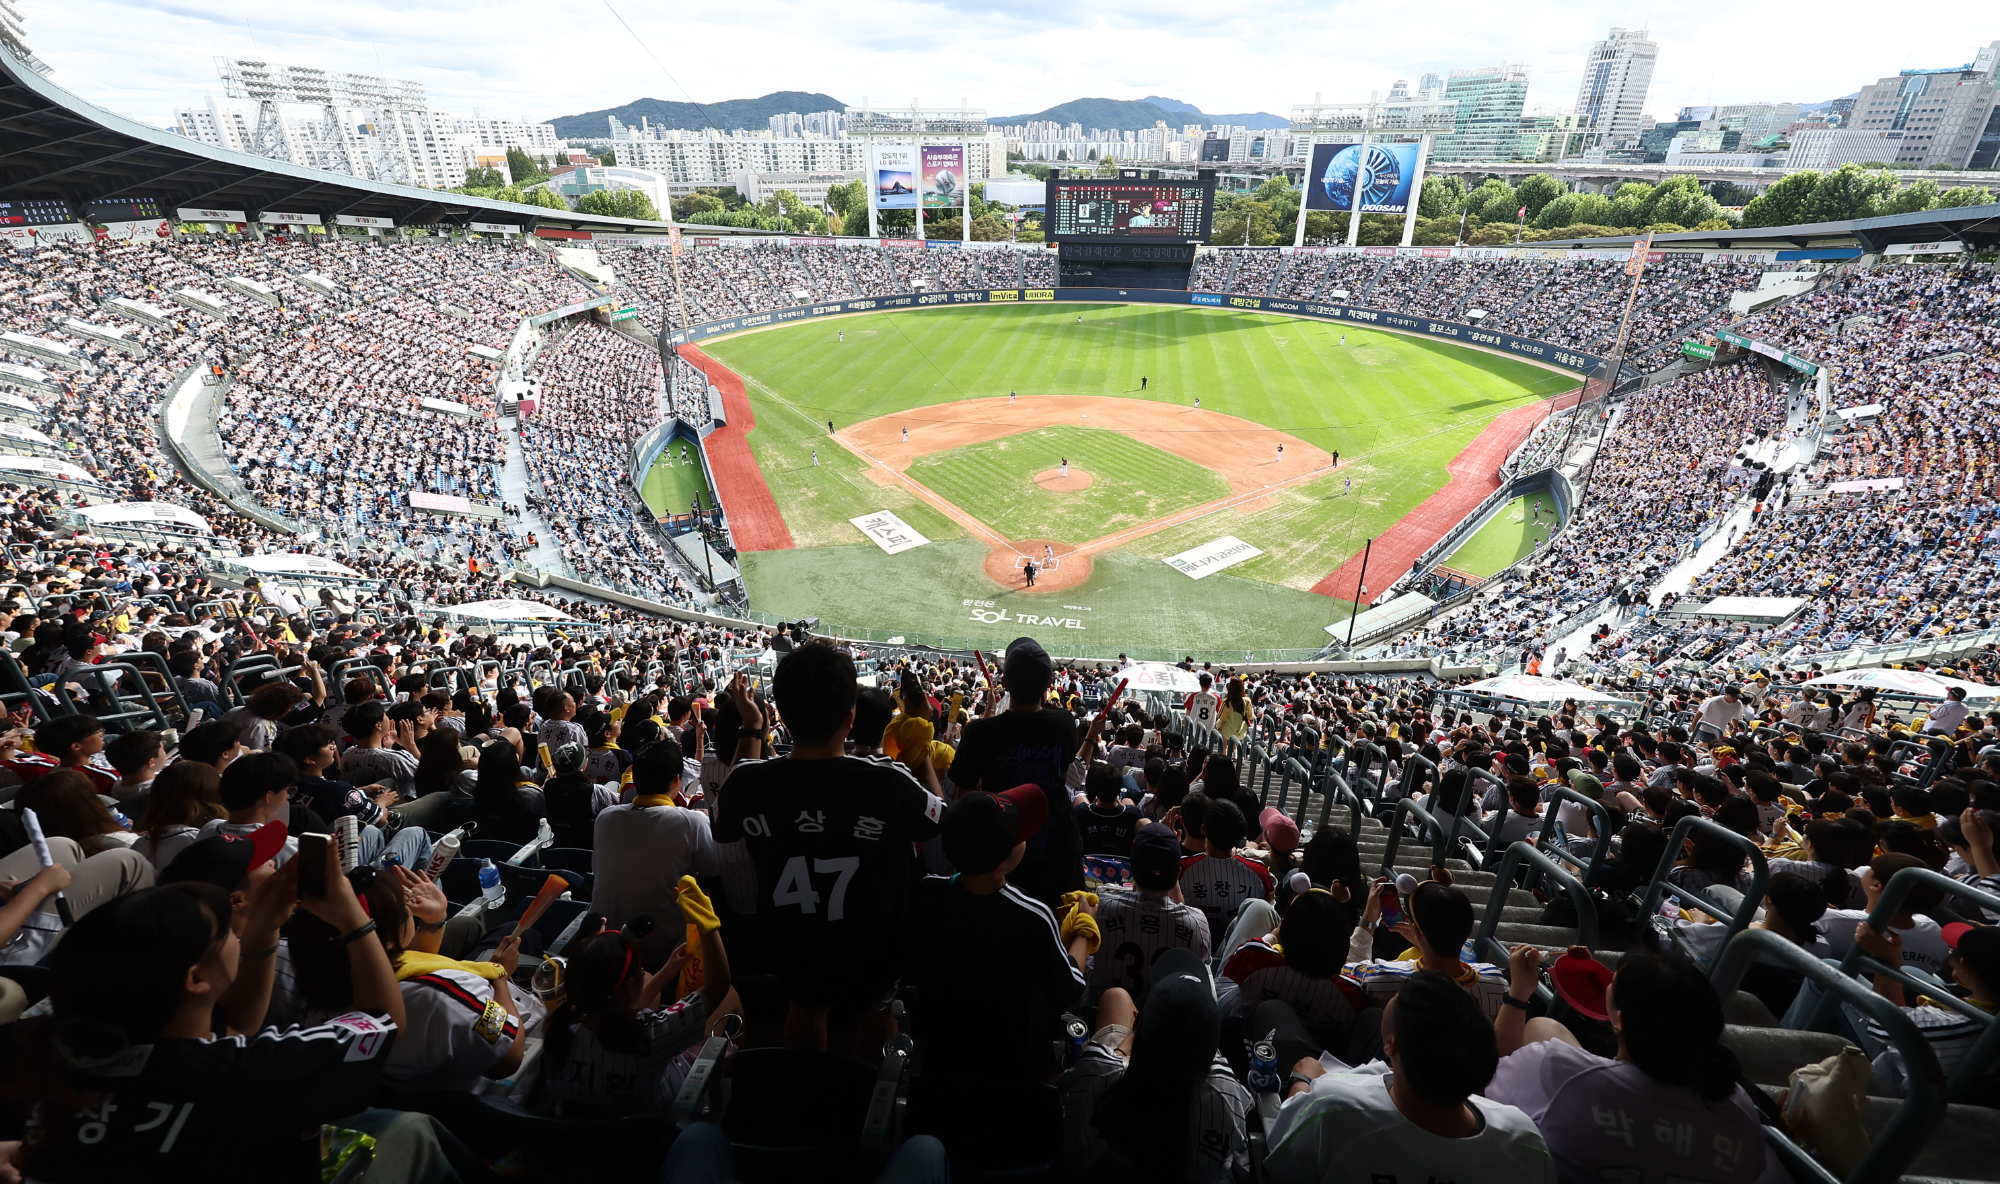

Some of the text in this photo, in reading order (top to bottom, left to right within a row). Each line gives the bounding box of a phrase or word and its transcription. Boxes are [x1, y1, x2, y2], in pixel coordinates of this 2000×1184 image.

[1361, 204, 1405, 212] DOOSAN
[1064, 246, 1189, 258] 한국경제신문 한국경제TV
[928, 294, 948, 303] 금강주택
[954, 292, 982, 302] 현대해상
[1230, 297, 1261, 308] 대방건설
[1269, 301, 1299, 310] HANCOM
[1317, 306, 1341, 316] 대보건설
[778, 310, 805, 320] 한국경제신문
[1348, 309, 1378, 321] 치킨마루
[1386, 316, 1418, 328] 한국경제TV
[1553, 351, 1585, 368] 키움증권
[1180, 543, 1252, 572] 메디카코리아
[962, 598, 996, 608] 환전은
[968, 608, 1086, 630] SOL TRAVEL
[1199, 707, 1209, 720] 8
[1801, 715, 1814, 724] 17
[742, 810, 886, 841] 이상훈
[772, 855, 860, 922] 47
[1192, 881, 1252, 898] 홍창기
[1106, 914, 1194, 946] 박용택
[478, 999, 496, 1028] TWINS
[1592, 1106, 1744, 1173] 박해민
